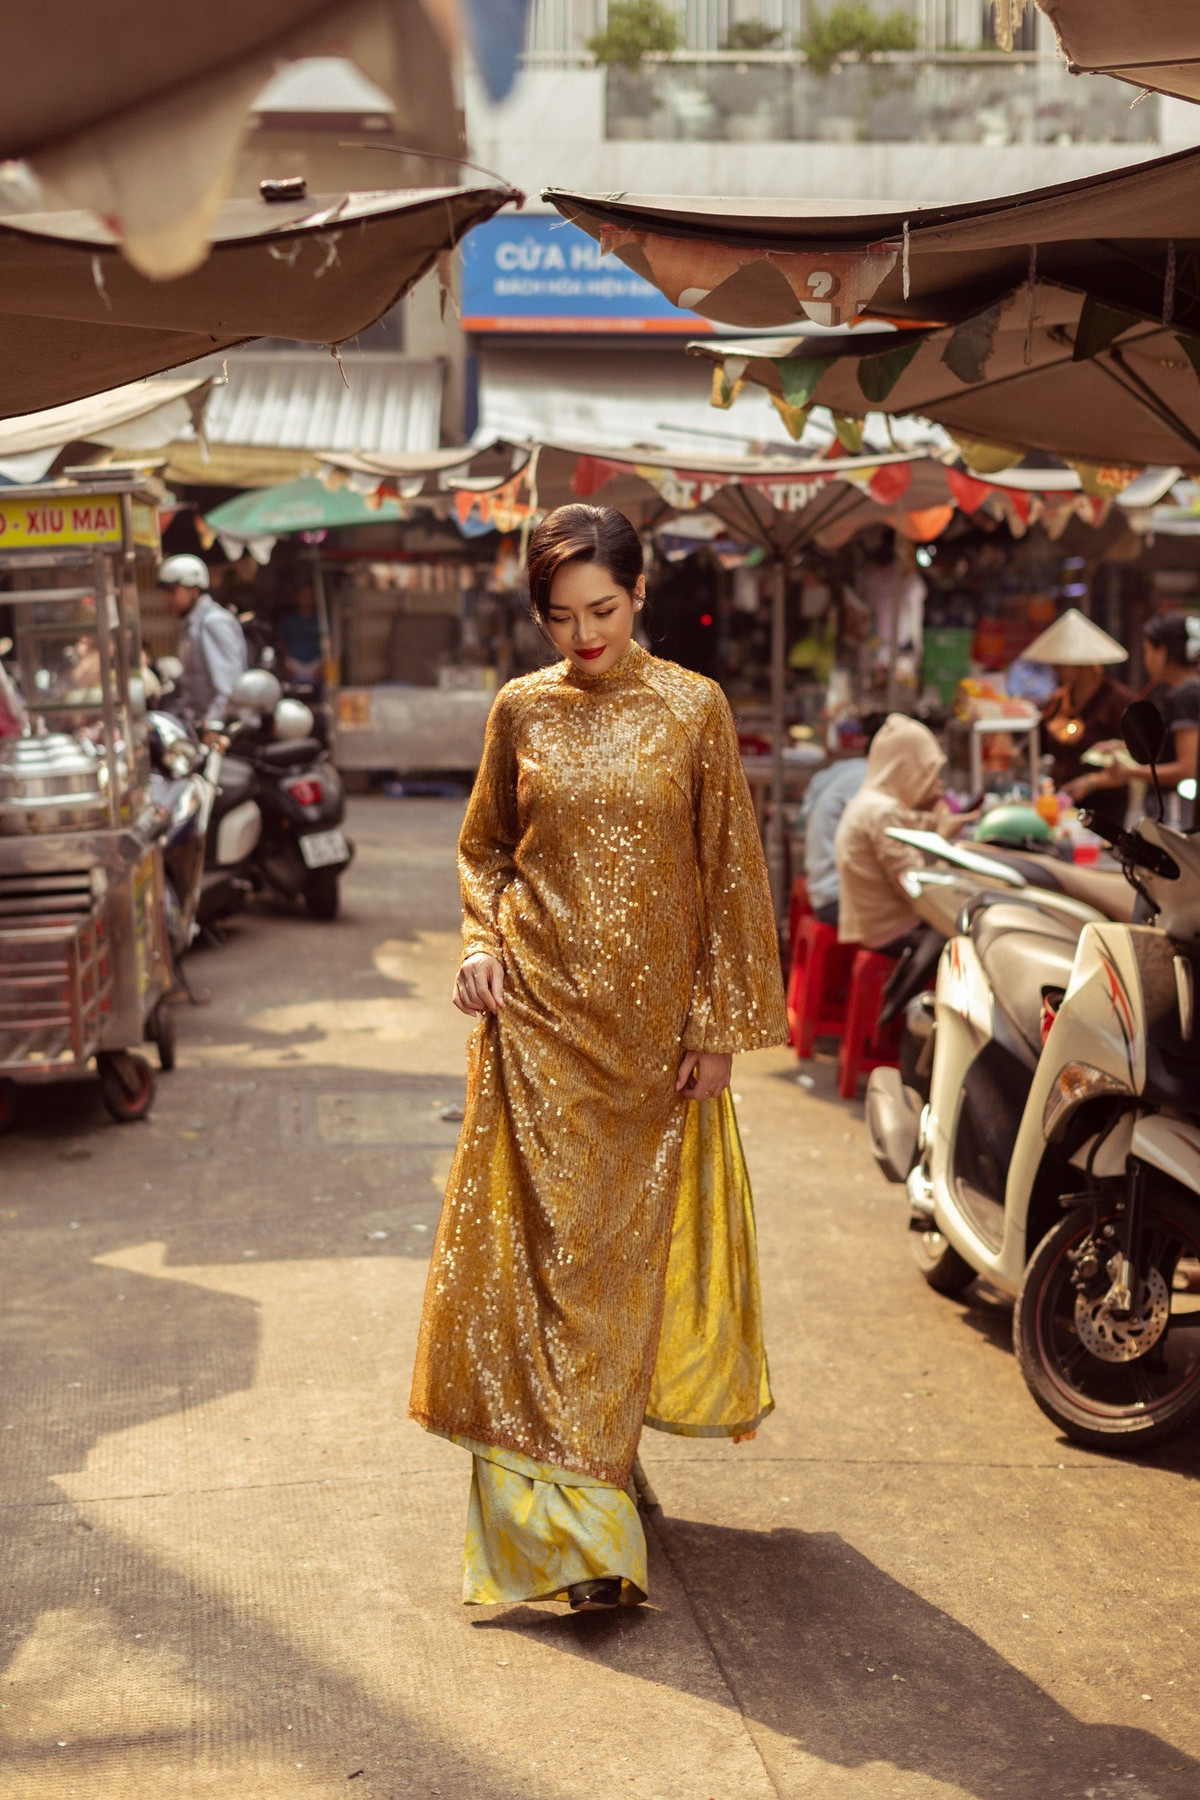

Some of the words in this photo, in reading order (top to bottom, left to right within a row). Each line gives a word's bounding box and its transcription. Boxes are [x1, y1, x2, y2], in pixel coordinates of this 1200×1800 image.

[495, 235, 567, 271] CỬA
[25, 503, 65, 535] XÍU
[71, 506, 116, 538] MẠI
